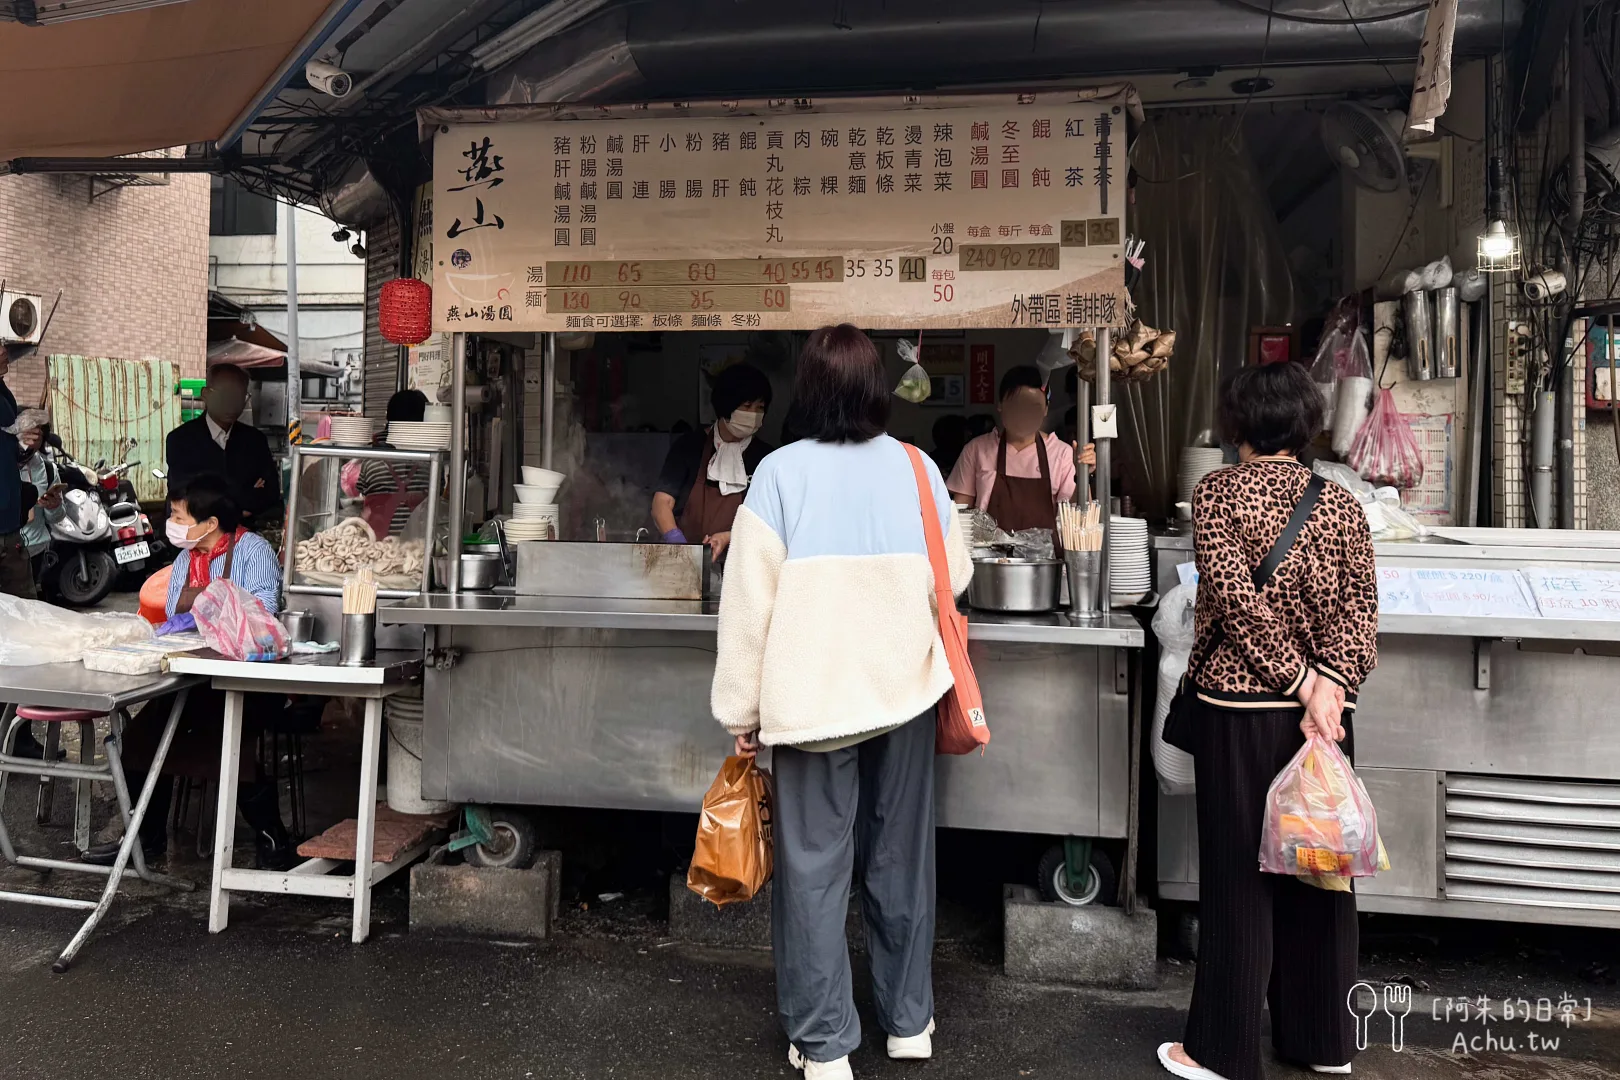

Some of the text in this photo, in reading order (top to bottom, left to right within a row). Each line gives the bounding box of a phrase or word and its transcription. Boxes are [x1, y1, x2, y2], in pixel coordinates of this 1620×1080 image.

[607, 135, 623, 199] 鹹湯圓
[848, 127, 866, 194] 乾意麵
[876, 126, 894, 193] 乾板條
[904, 125, 922, 192] 燙青菜
[934, 123, 953, 192] 辣泡菜
[971, 121, 989, 189] 鹹湯圓
[1001, 120, 1020, 188] 冬至圓
[554, 136, 571, 246] 豬肝鹹湯圓
[580, 135, 597, 246] 粉腸鹹湯圓
[931, 223, 954, 234] 小盤
[967, 224, 1052, 237] 每盒 每斤 每盒
[933, 237, 953, 254] 20
[966, 247, 1054, 268] 240 90 220
[527, 258, 925, 283] 湯 110 65 60 40 55 45 35 35 40
[932, 269, 955, 280] 每包
[526, 289, 784, 312] 麵 130 90 85 60
[934, 284, 953, 302] 50
[446, 304, 512, 322] 燕山湯圓
[653, 314, 682, 327] 板條
[692, 314, 721, 327] 麵條
[731, 313, 761, 326] 冬粉
[1011, 293, 1116, 324] 外帶區 請排隊
